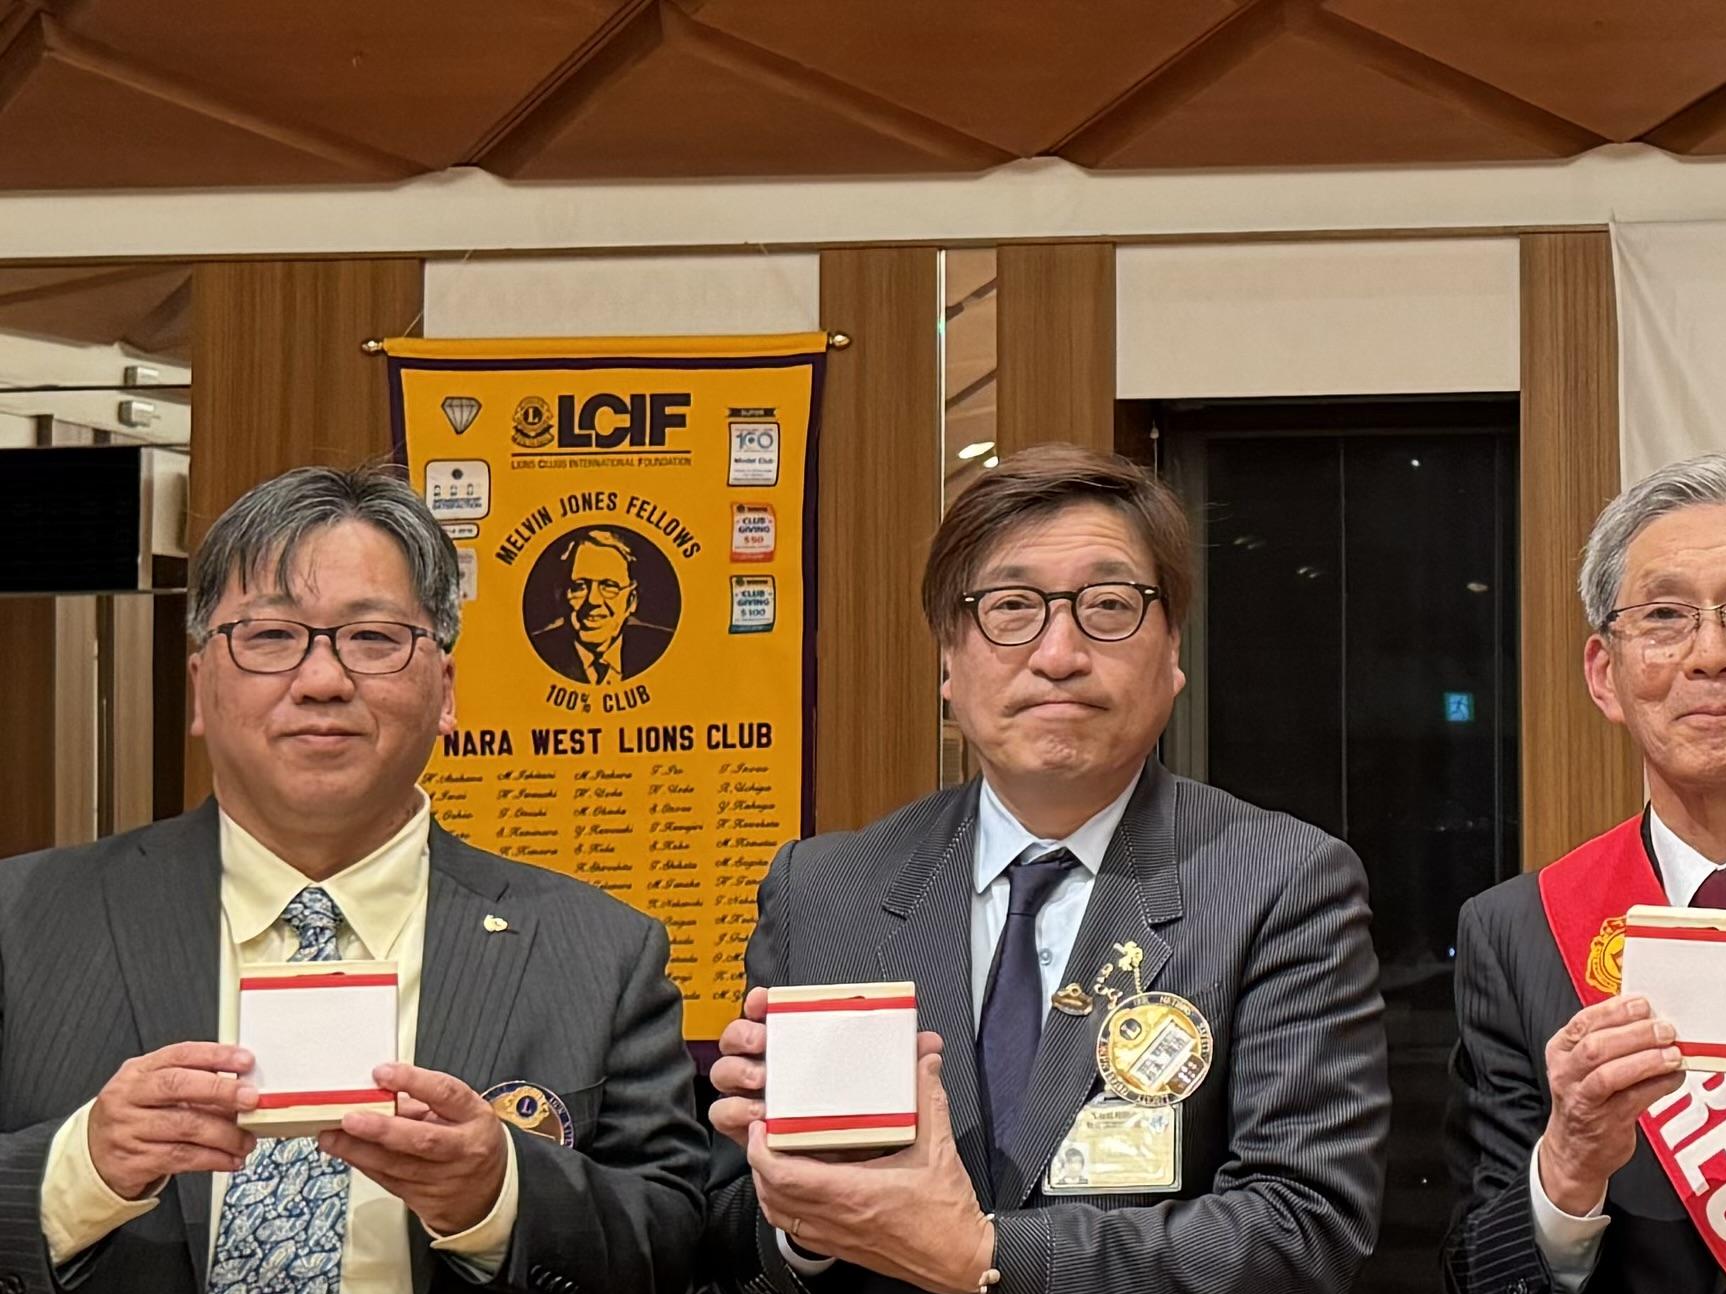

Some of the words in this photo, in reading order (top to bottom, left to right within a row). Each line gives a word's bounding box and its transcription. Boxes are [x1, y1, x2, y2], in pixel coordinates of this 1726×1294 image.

[558, 393, 691, 448] LCIF
[495, 509, 553, 566] MELVIN
[559, 492, 617, 516] JONES
[626, 496, 701, 561] FELLOWS
[546, 684, 592, 713] 100%
[602, 685, 651, 712] CLUB
[443, 729, 513, 757] NARA
[531, 727, 603, 755] WEST
[619, 725, 694, 753] LIONS
[707, 723, 773, 750] CLUB
